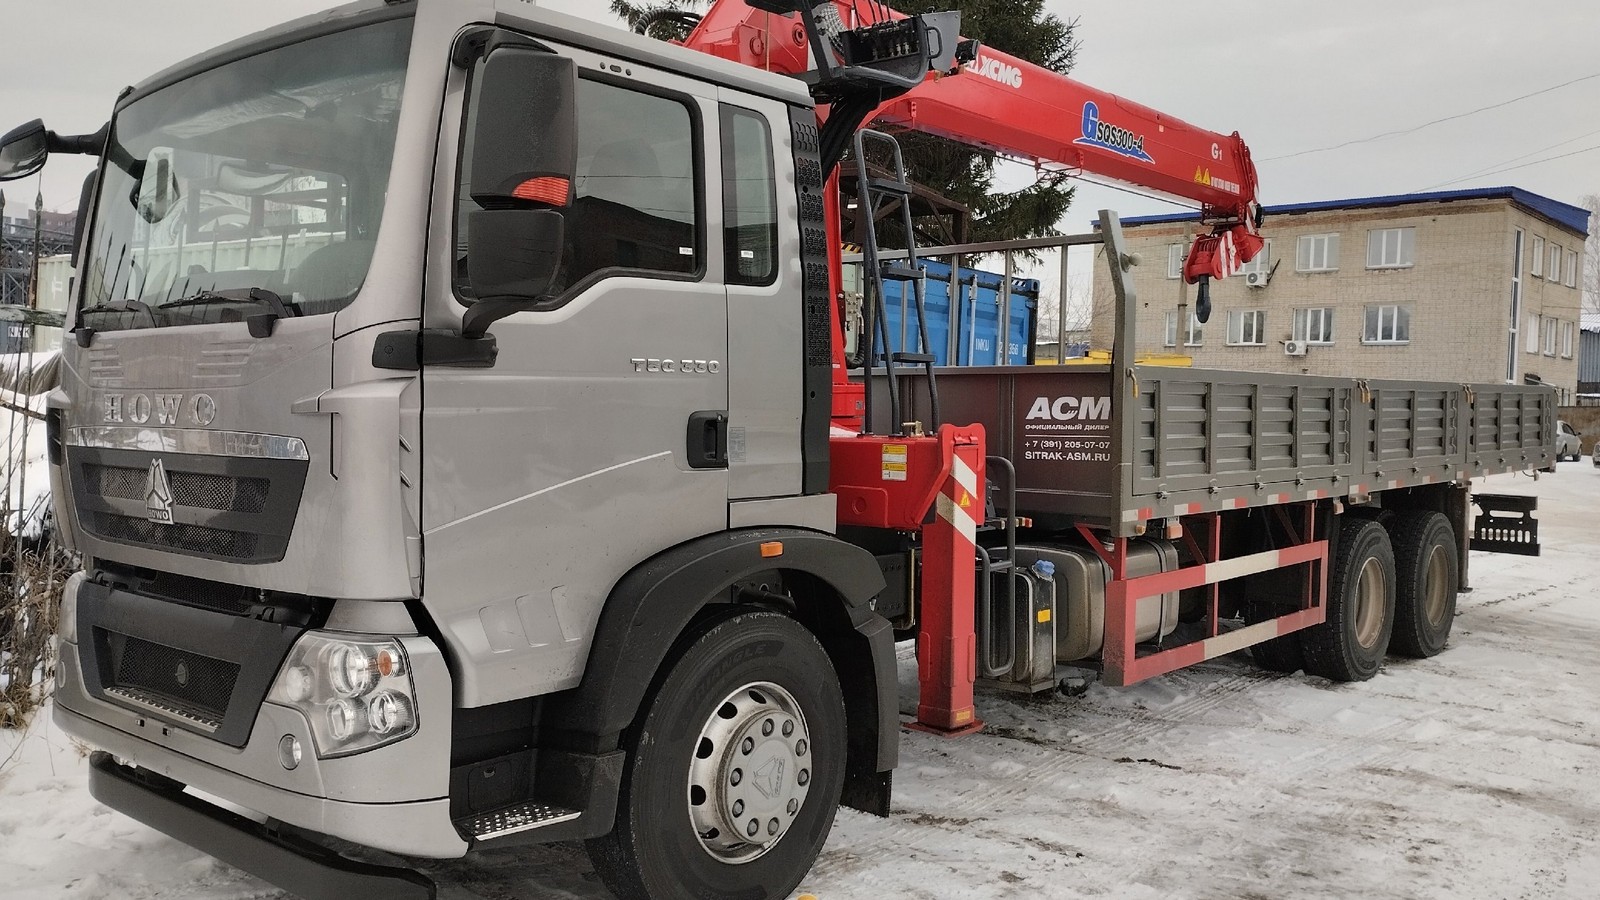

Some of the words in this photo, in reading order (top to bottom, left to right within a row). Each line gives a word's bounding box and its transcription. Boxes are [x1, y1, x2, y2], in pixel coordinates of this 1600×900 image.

[979, 55, 1022, 89] XCMG
[103, 393, 217, 426] HOWO
[1025, 423, 1082, 431] ОФИЦИАЛЬНЫЙ
[1040, 440, 1062, 450] (391)
[1064, 441, 1111, 449] 205-07-07
[1025, 451, 1111, 461] SITRAK-ASM.RU
